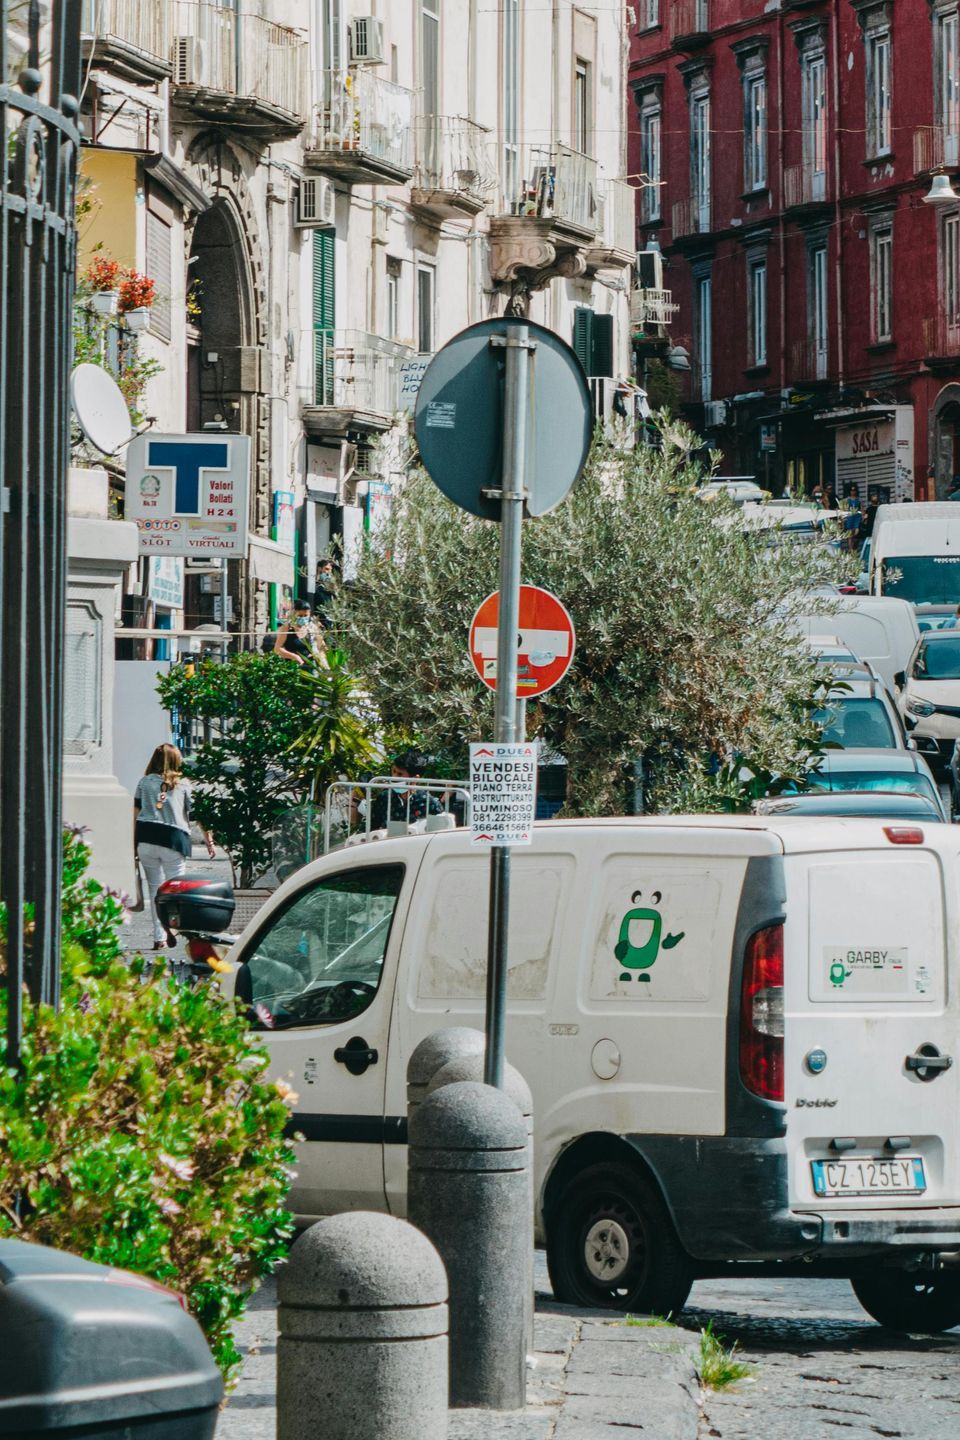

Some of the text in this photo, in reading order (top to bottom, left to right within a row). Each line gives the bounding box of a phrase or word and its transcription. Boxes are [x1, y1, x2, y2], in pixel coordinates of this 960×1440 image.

[400, 362, 427, 372] LIGH
[403, 374, 424, 383] BLU
[401, 384, 420, 393] HO
[148, 441, 228, 514] T
[209, 480, 234, 490] Valori
[209, 493, 233, 503] Bollati
[141, 539, 172, 547] SLOT
[188, 540, 235, 549] VIRTUALI
[472, 762, 534, 773] VENDESI
[472, 773, 534, 783] BILOCALE
[472, 783, 532, 792] PIANO TERRA
[472, 793, 533, 803] RISTRUTTURATO
[473, 804, 533, 813] LUMINOSO
[847, 950, 888, 964] GARBY
[827, 1162, 910, 1188] CZ 125EY
